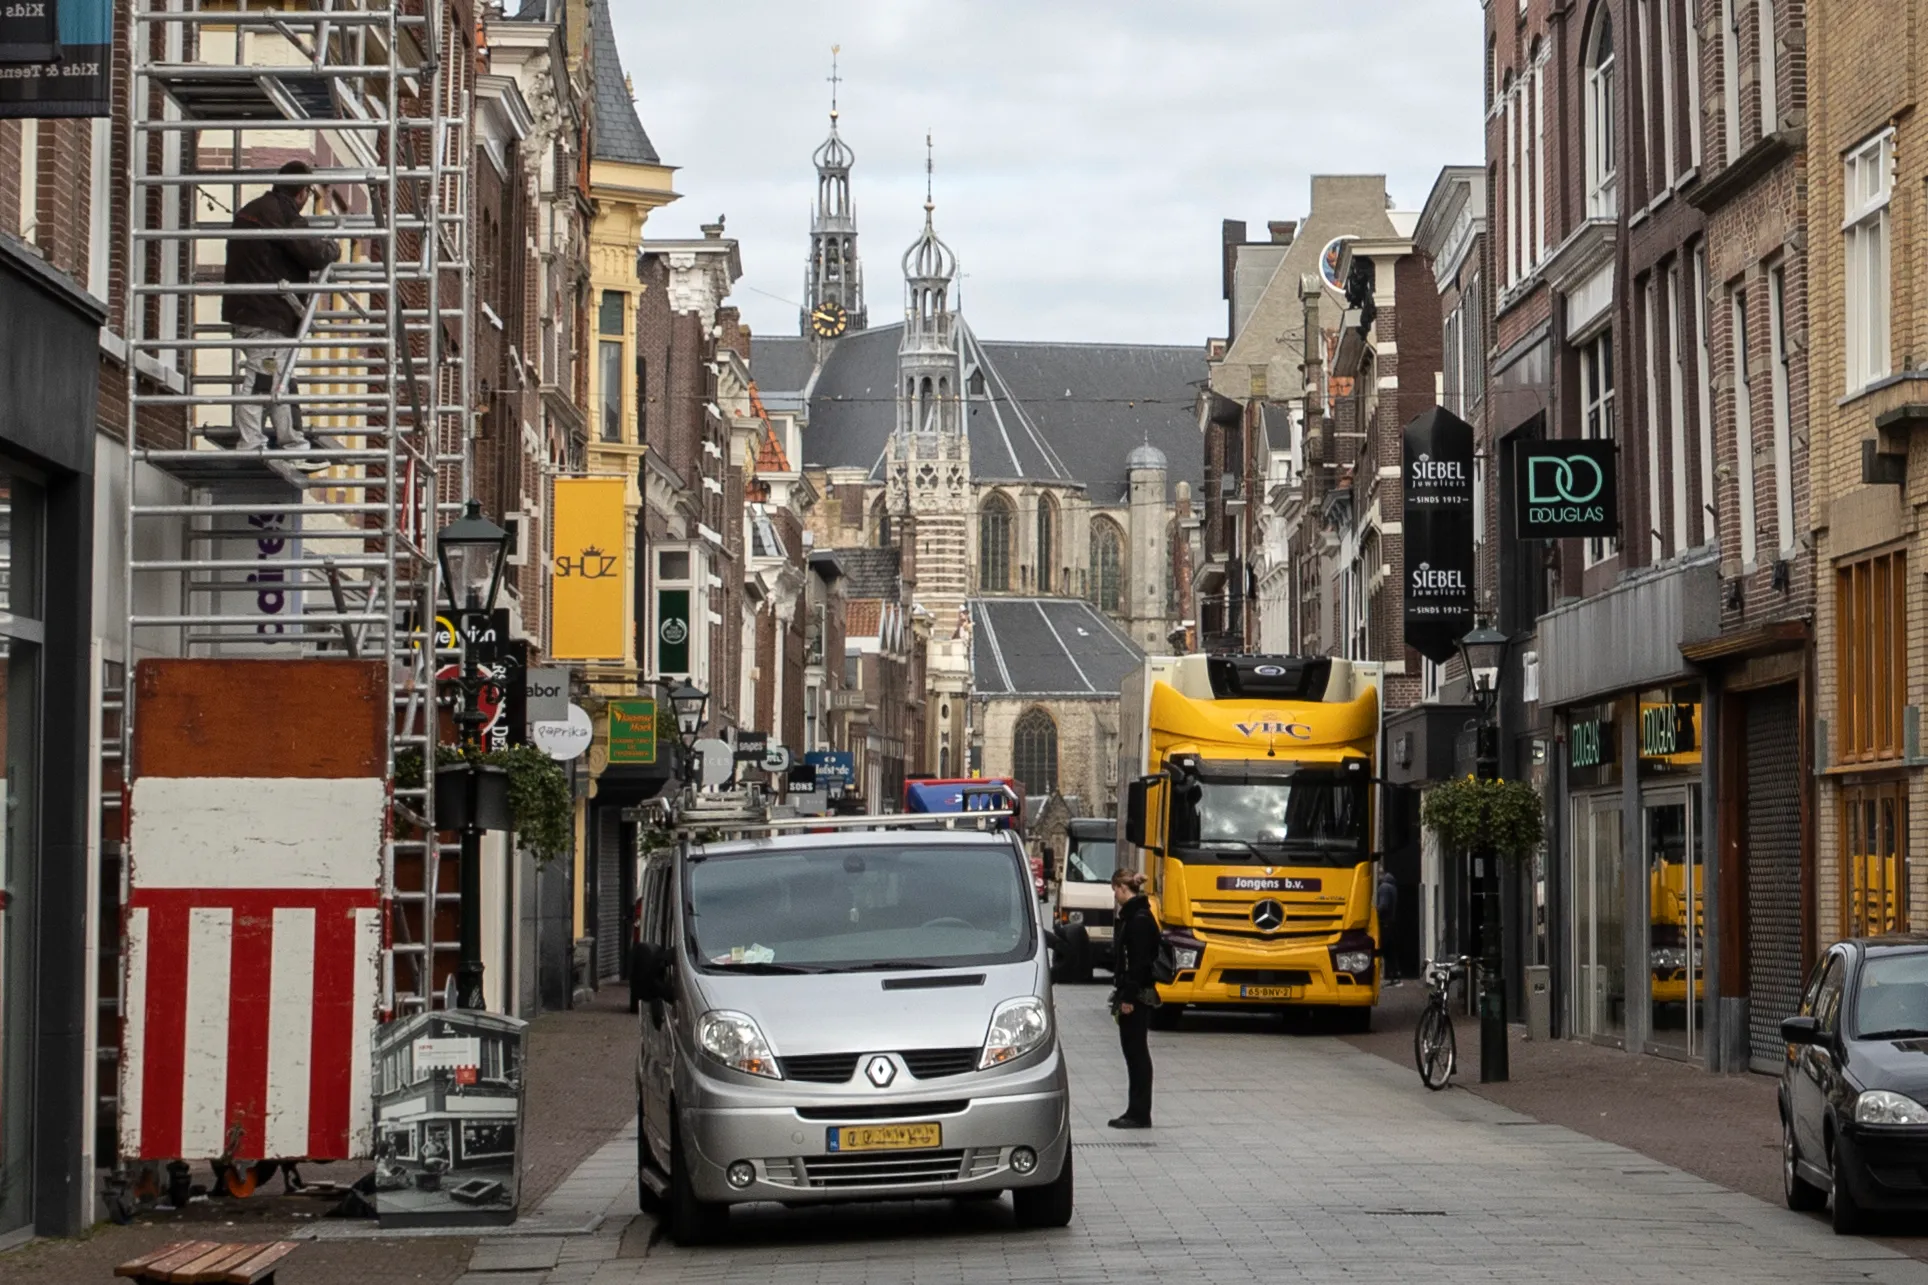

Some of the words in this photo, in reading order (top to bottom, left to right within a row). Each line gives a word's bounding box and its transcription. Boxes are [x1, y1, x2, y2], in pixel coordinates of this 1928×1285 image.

[1412, 462, 1465, 480] SIEBEL
[1416, 496, 1439, 504] SINDS
[1443, 496, 1461, 504] 1912
[1529, 507, 1604, 523] DOUGLAS
[1412, 570, 1466, 588] SIEBEL
[526, 683, 561, 697] abor
[835, 695, 861, 707] WE
[1233, 722, 1311, 740] VHC
[1644, 703, 1677, 756] DOUGLAS
[1572, 719, 1600, 767] DOUGLAS
[789, 782, 813, 791] SONS
[1235, 877, 1279, 890] Jongens
[1285, 878, 1304, 889] b.v.
